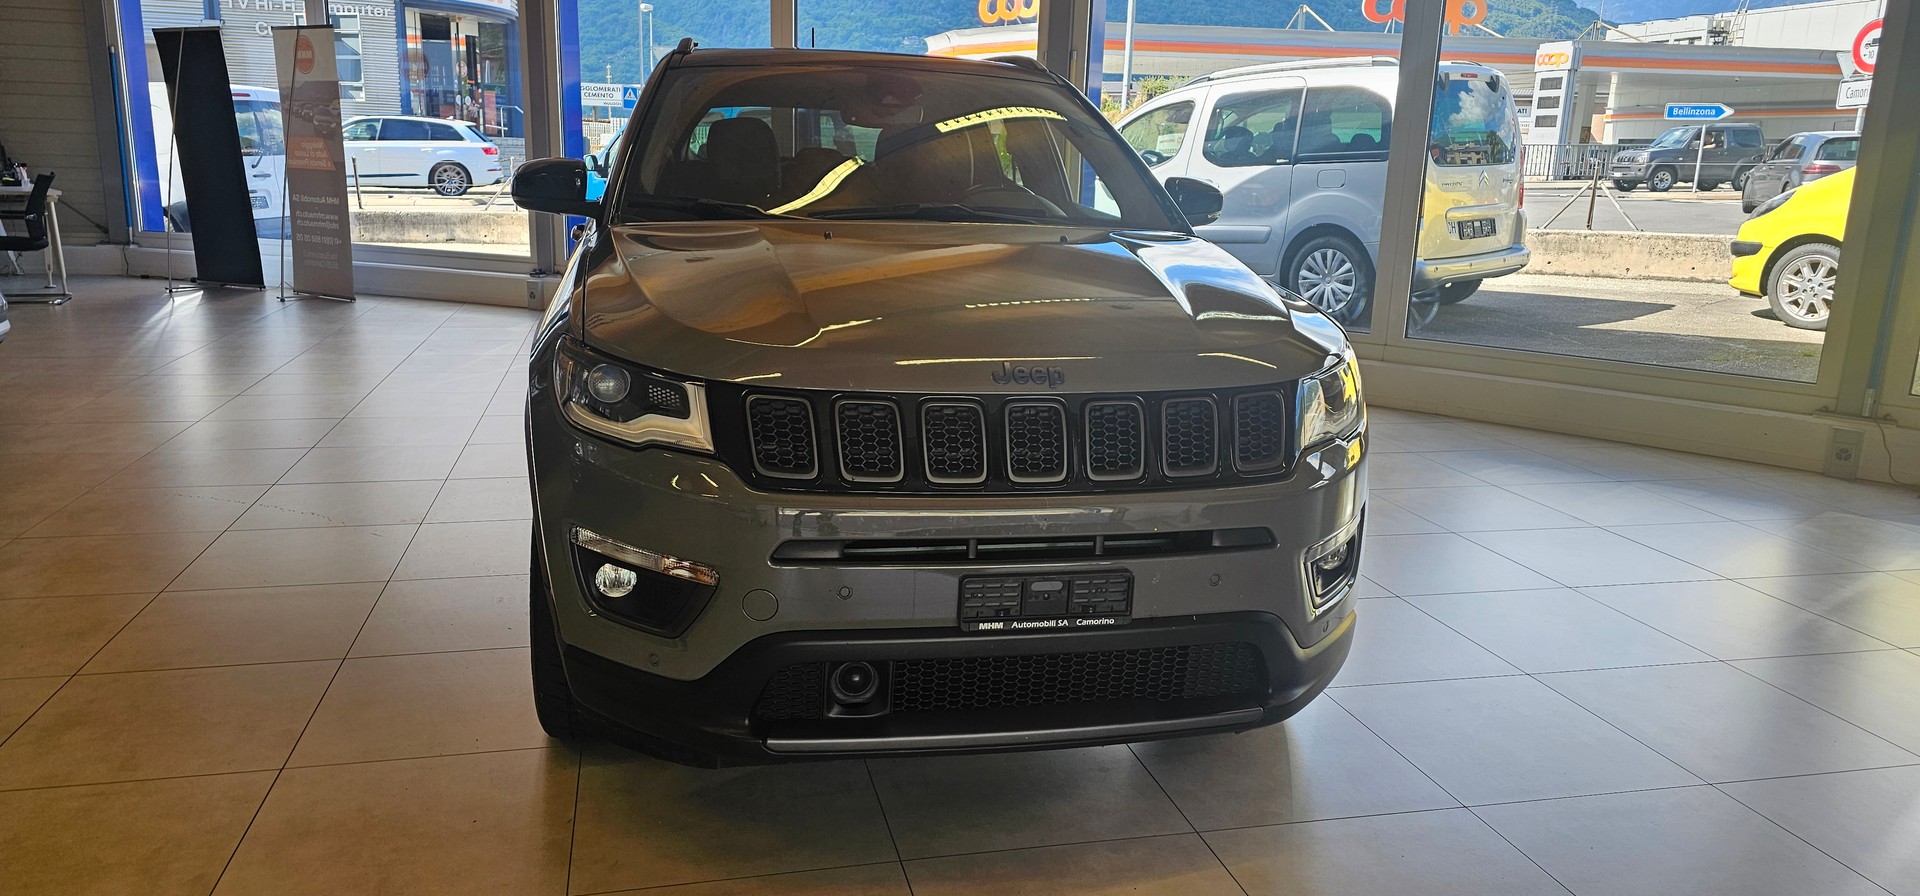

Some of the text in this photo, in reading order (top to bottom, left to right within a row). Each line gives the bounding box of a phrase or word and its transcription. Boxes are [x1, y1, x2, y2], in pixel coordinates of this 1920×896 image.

[1537, 52, 1569, 68] coop
[580, 85, 621, 93] GGLOMERATI
[1845, 84, 1870, 99] Camori
[1672, 106, 1716, 116] Bellinzona
[991, 360, 1066, 389] Jeep
[978, 617, 1115, 631] MHM Automobili SA Camorino
